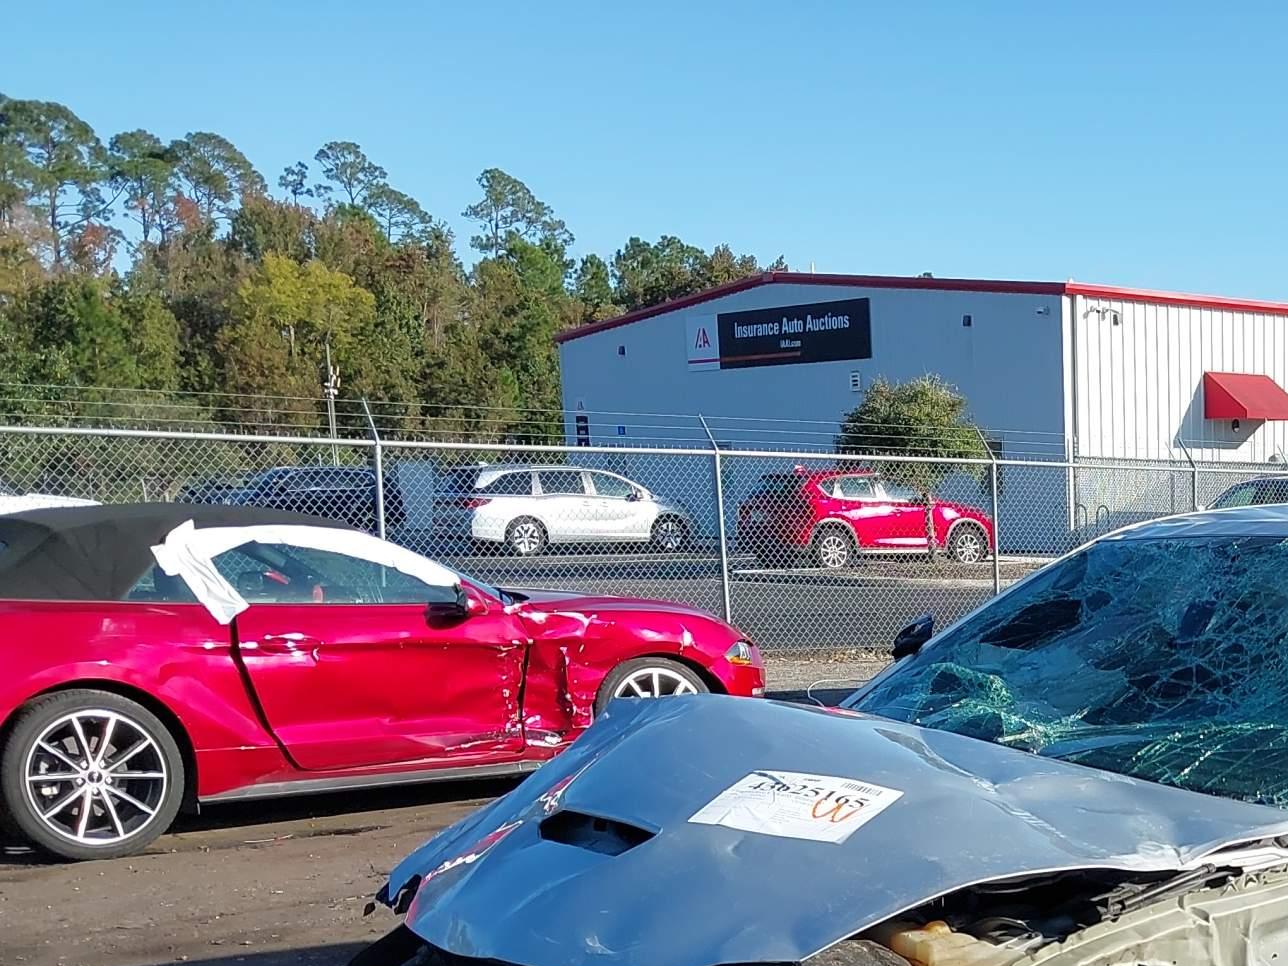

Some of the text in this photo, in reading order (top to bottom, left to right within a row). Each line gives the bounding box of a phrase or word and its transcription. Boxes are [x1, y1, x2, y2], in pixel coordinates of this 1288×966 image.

[734, 312, 850, 339] Insurance Auto Auctions
